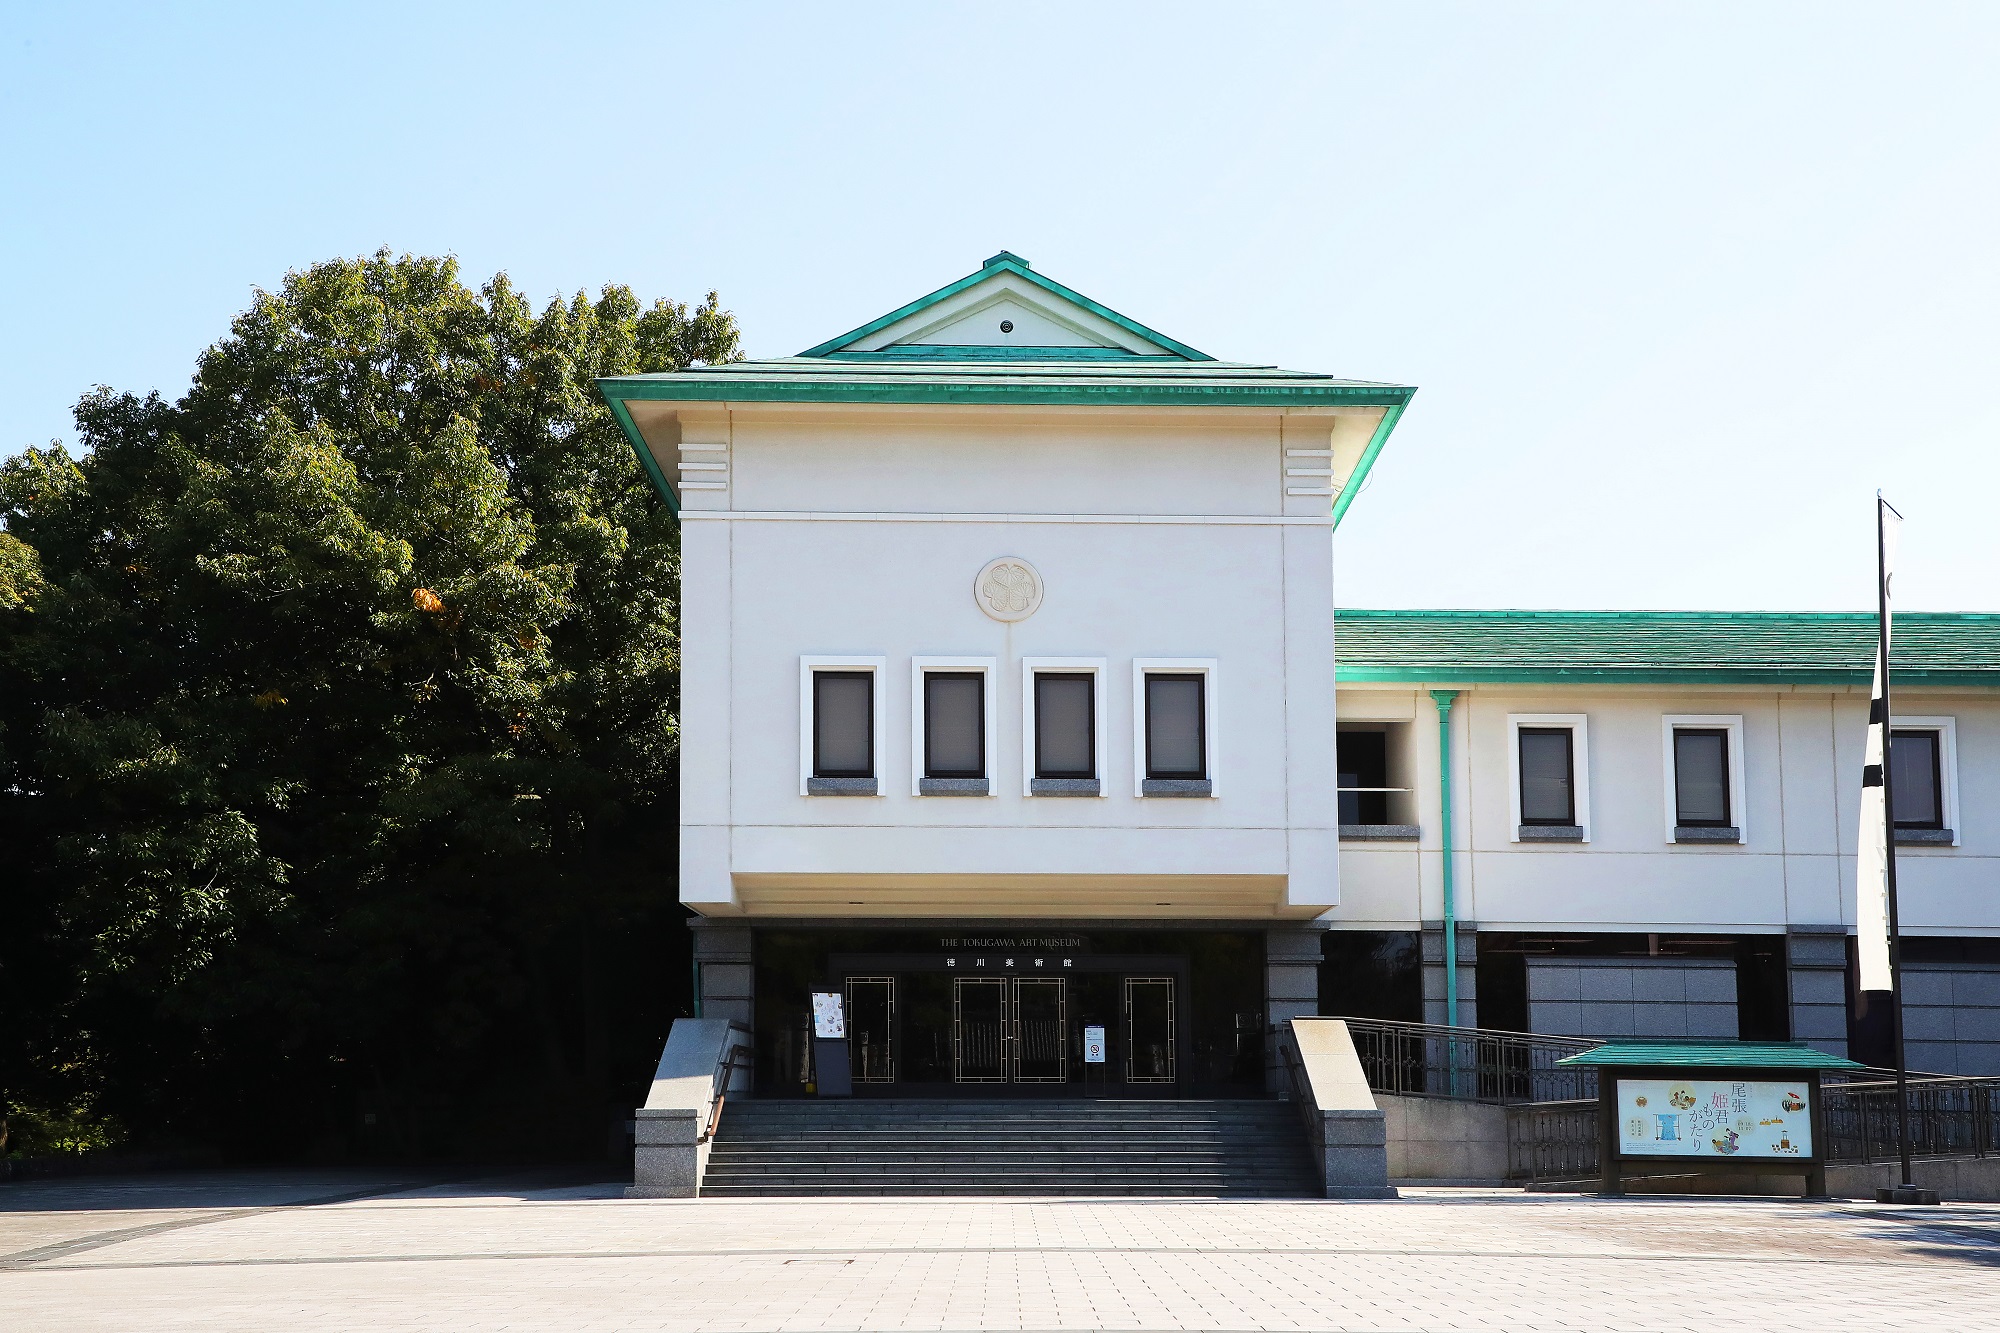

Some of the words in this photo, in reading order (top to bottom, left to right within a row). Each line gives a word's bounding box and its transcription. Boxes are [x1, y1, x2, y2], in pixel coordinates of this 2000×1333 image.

[941, 939, 958, 947] THE
[962, 939, 1016, 947] TOKUGAWA
[1019, 939, 1038, 947] ART
[1039, 939, 1080, 947] MUSEUM
[1711, 1091, 1729, 1124] 姫君
[1731, 1082, 1747, 1113] 尾張
[1689, 1110, 1703, 1152] がたり
[1702, 1103, 1715, 1130] もの
